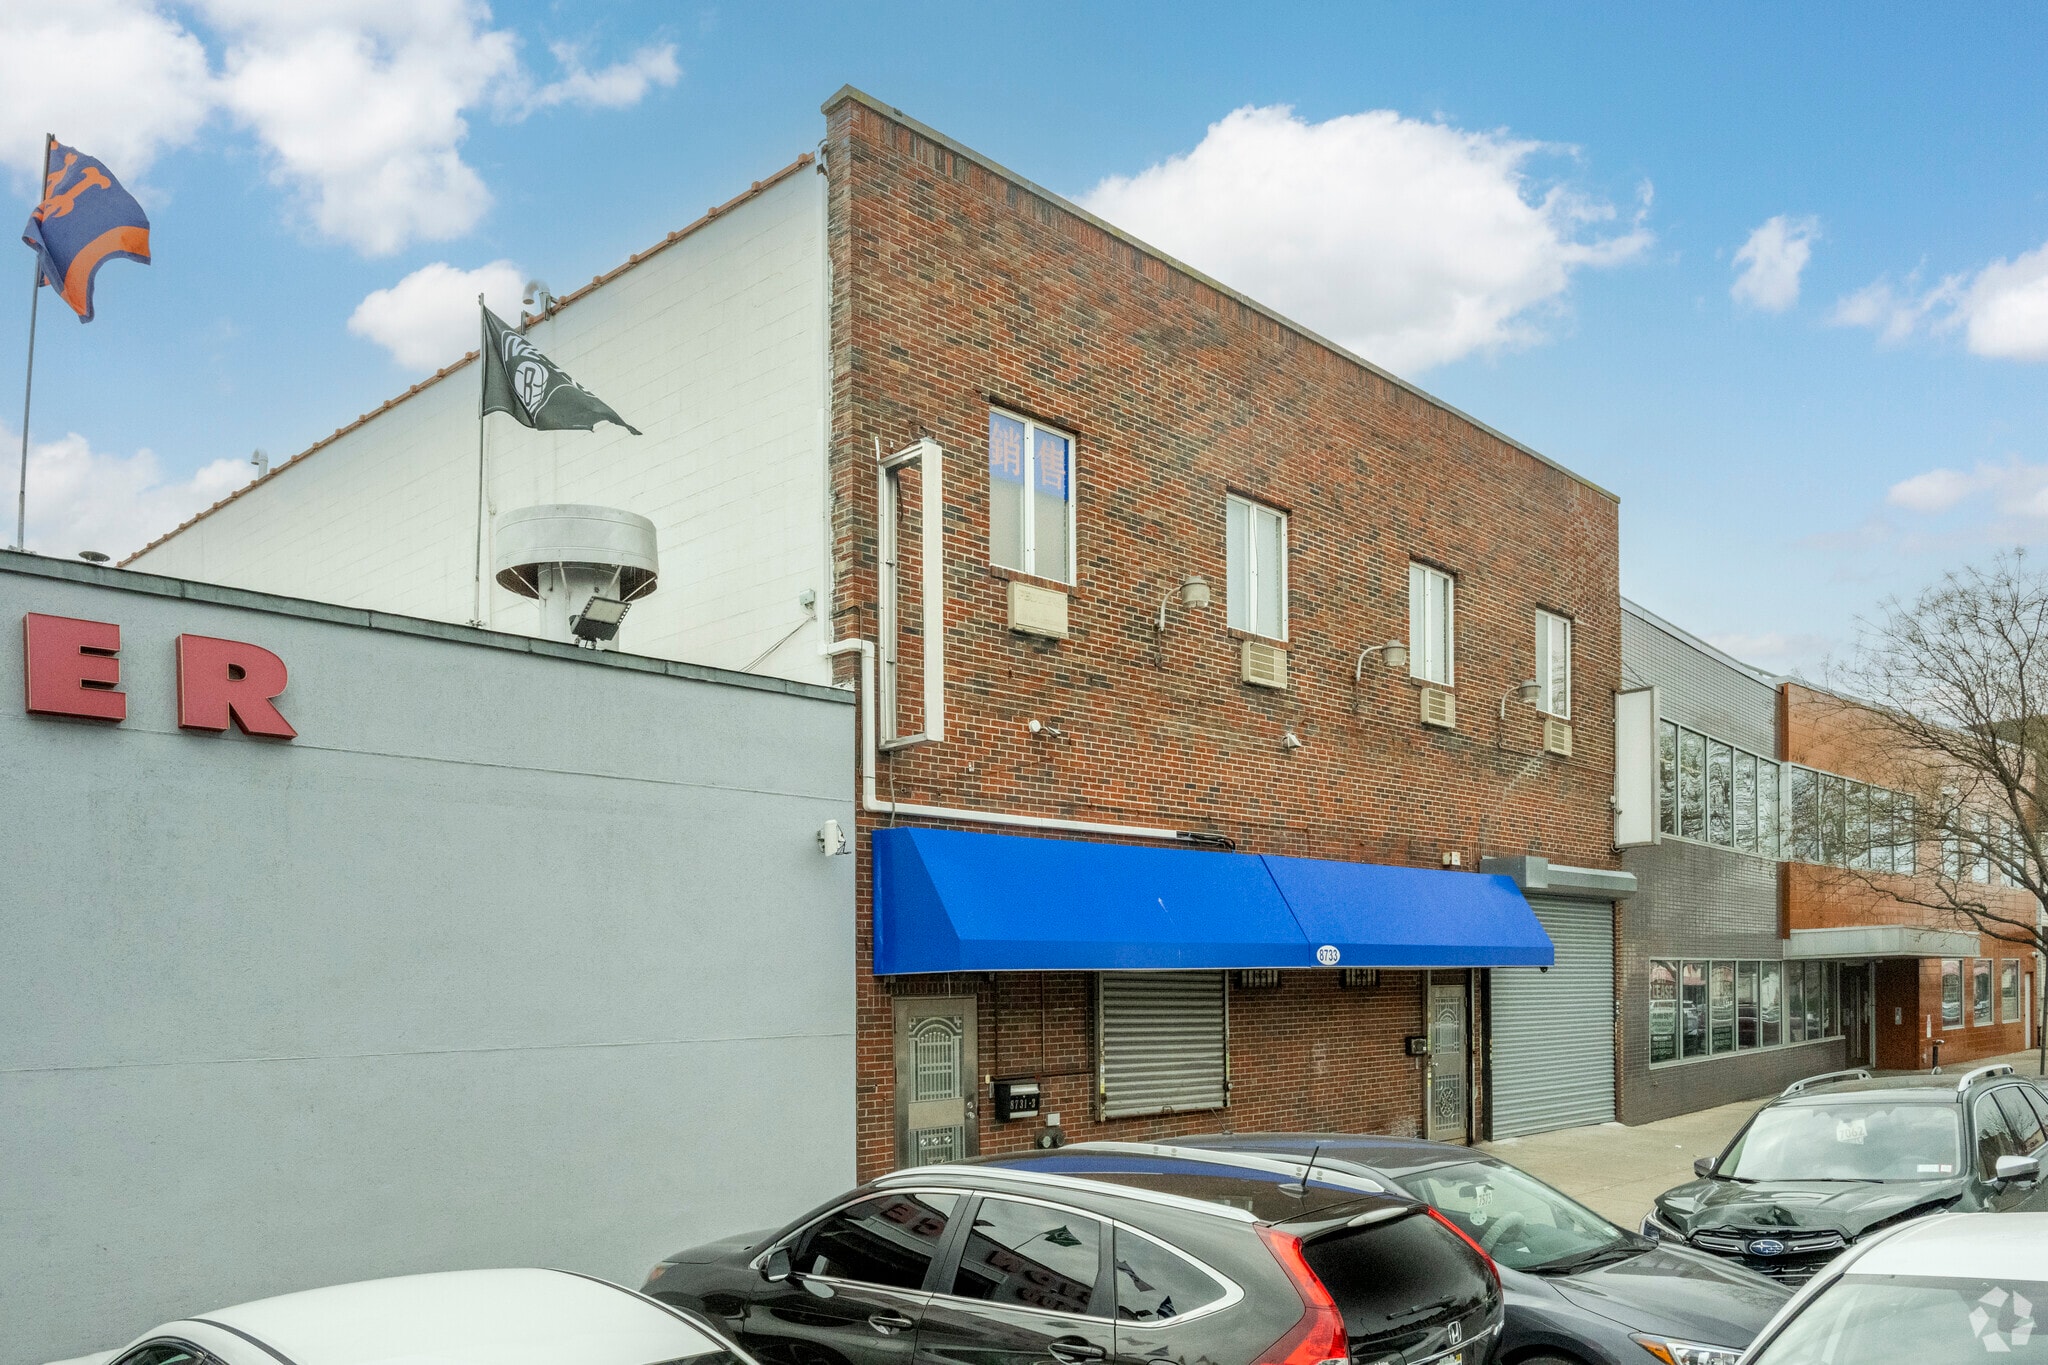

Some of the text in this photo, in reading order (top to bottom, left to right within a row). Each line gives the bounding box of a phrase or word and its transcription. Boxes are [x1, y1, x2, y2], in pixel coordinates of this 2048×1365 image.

[990, 420, 1066, 490] 銷售
[23, 612, 298, 740] ER
[1319, 948, 1338, 962] 8733
[1652, 984, 1675, 1000] LEASE
